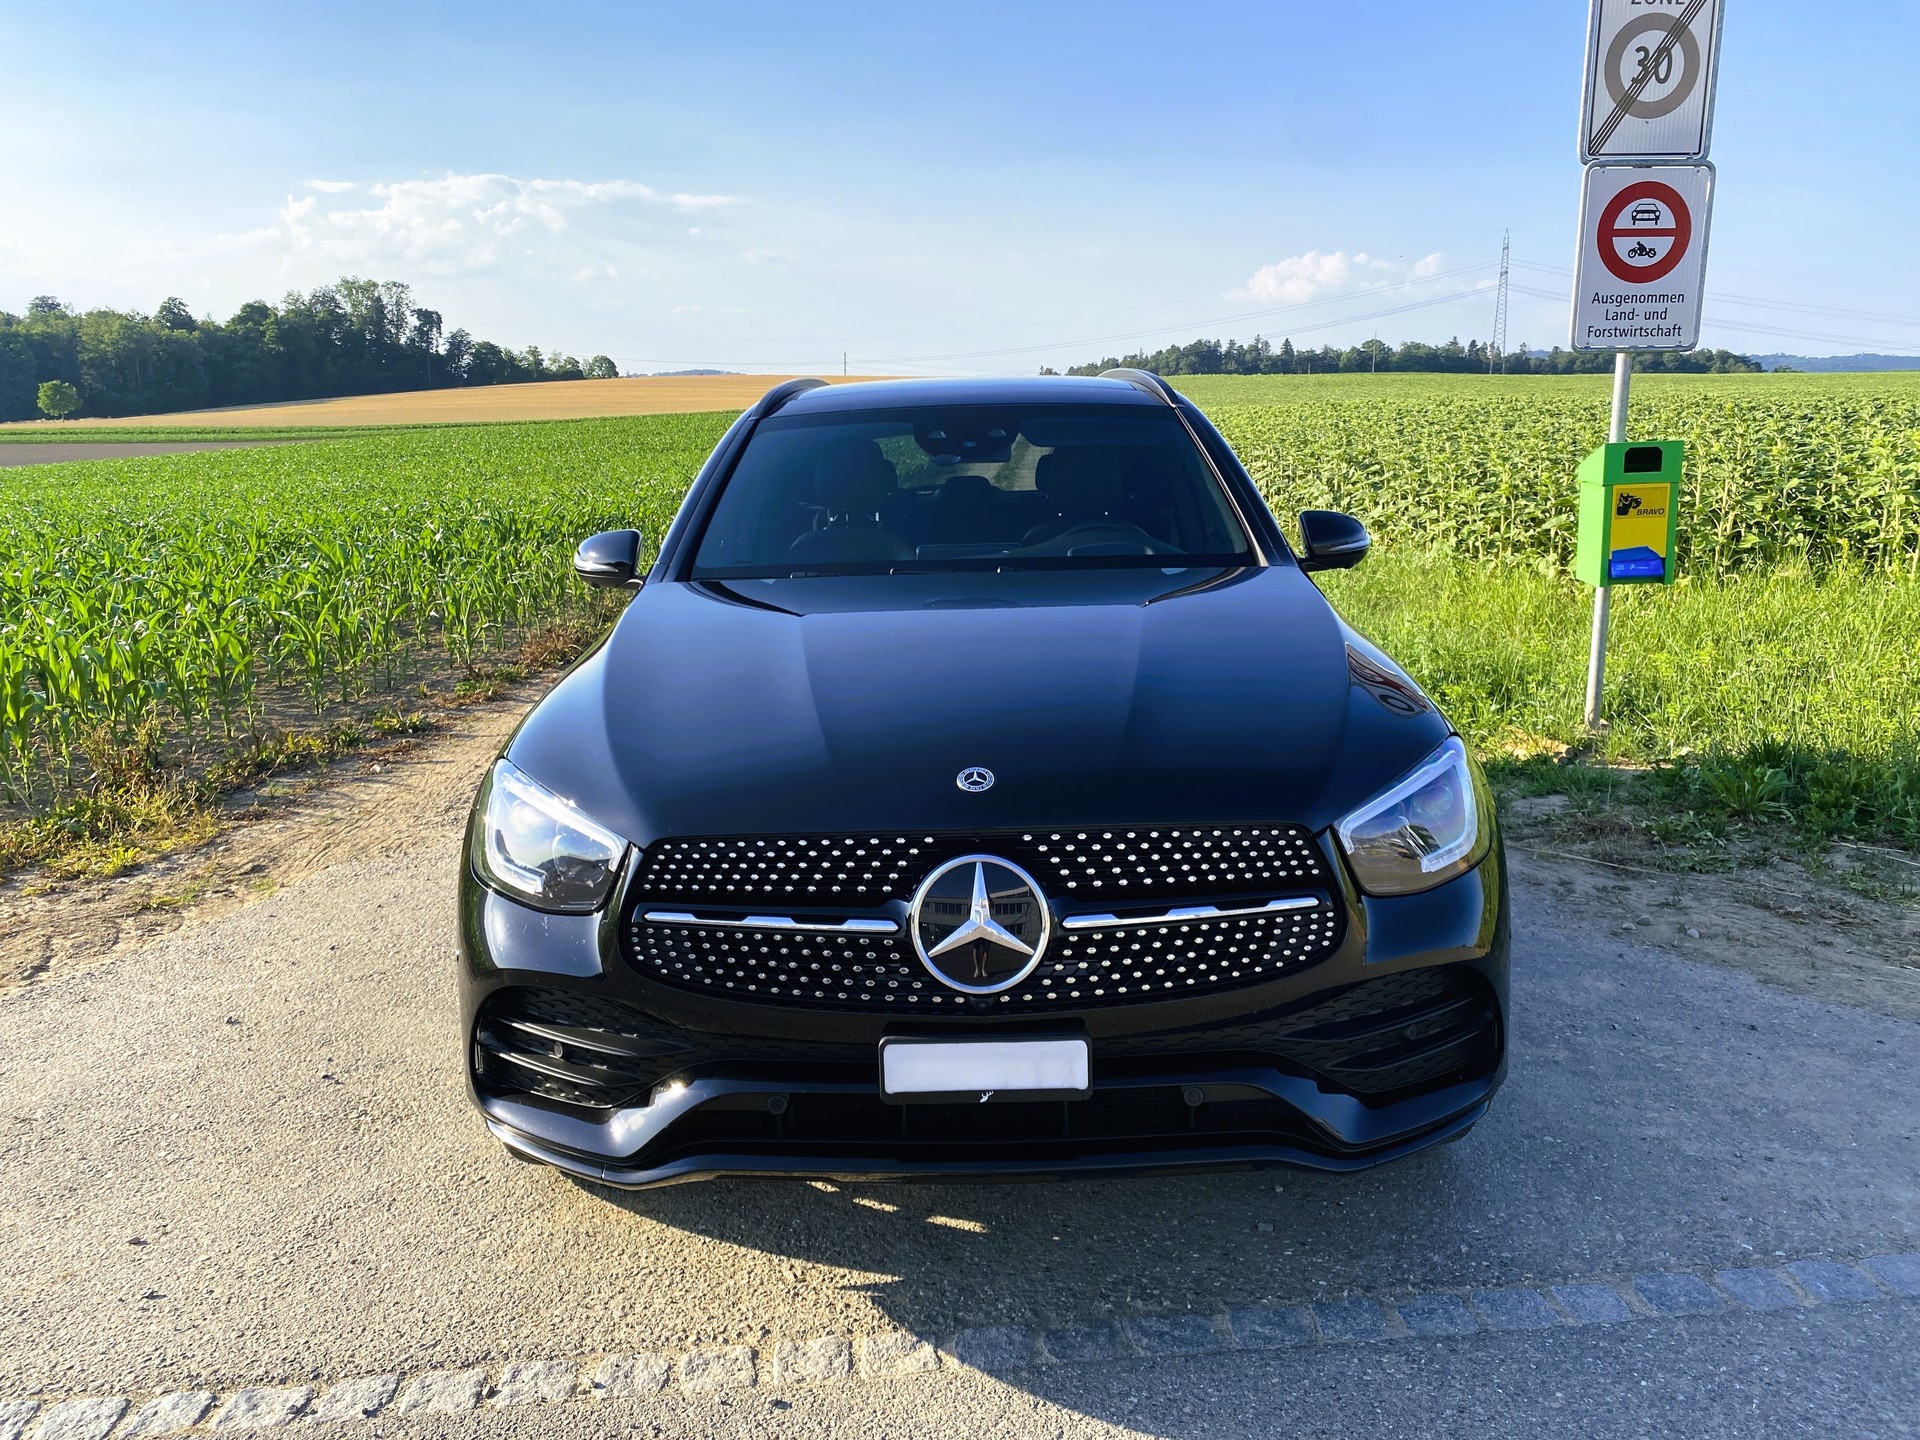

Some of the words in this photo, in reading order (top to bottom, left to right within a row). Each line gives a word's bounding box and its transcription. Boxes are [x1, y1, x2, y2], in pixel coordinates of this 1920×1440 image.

[1631, 45, 1673, 84] 30
[1591, 292, 1685, 307] Ausgenommen
[1605, 308, 1640, 321] Land-
[1644, 307, 1668, 320] und
[1587, 324, 1682, 338] Forstwirtschaft
